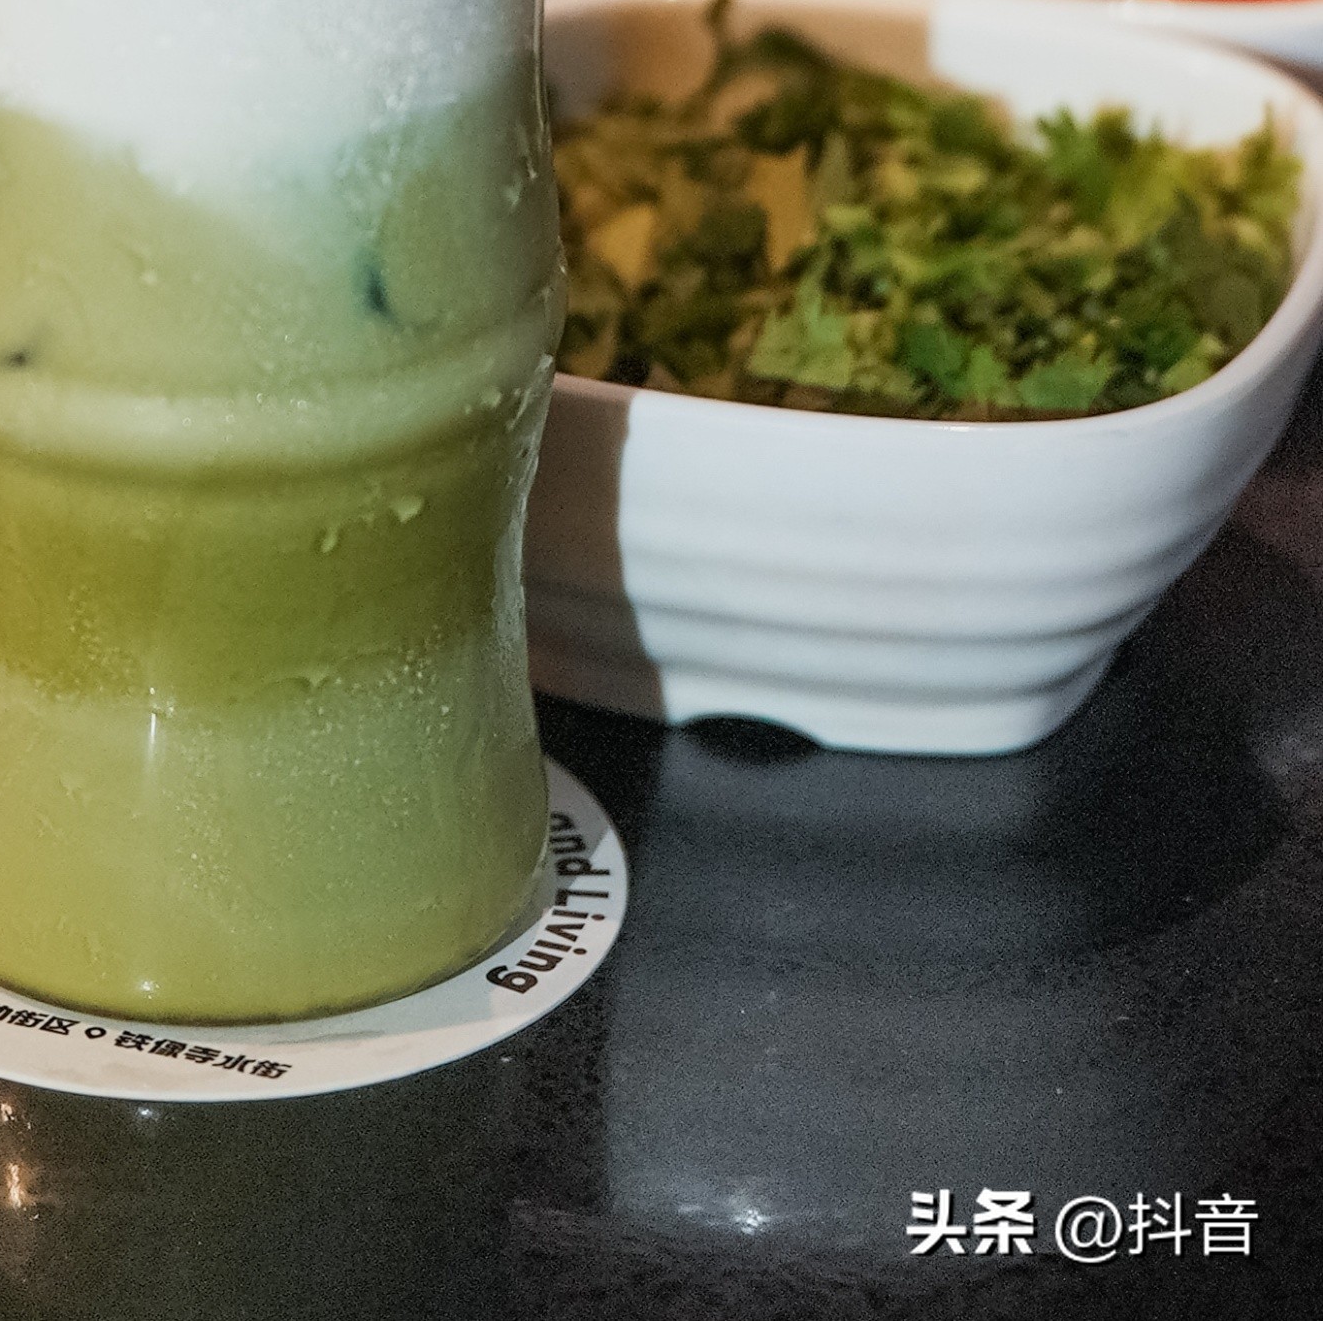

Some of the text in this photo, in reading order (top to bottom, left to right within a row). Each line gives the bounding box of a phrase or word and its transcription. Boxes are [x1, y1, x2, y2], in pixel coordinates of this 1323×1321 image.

[485, 888, 610, 995] Living
[114, 1030, 293, 1080] 铁像寺水街
